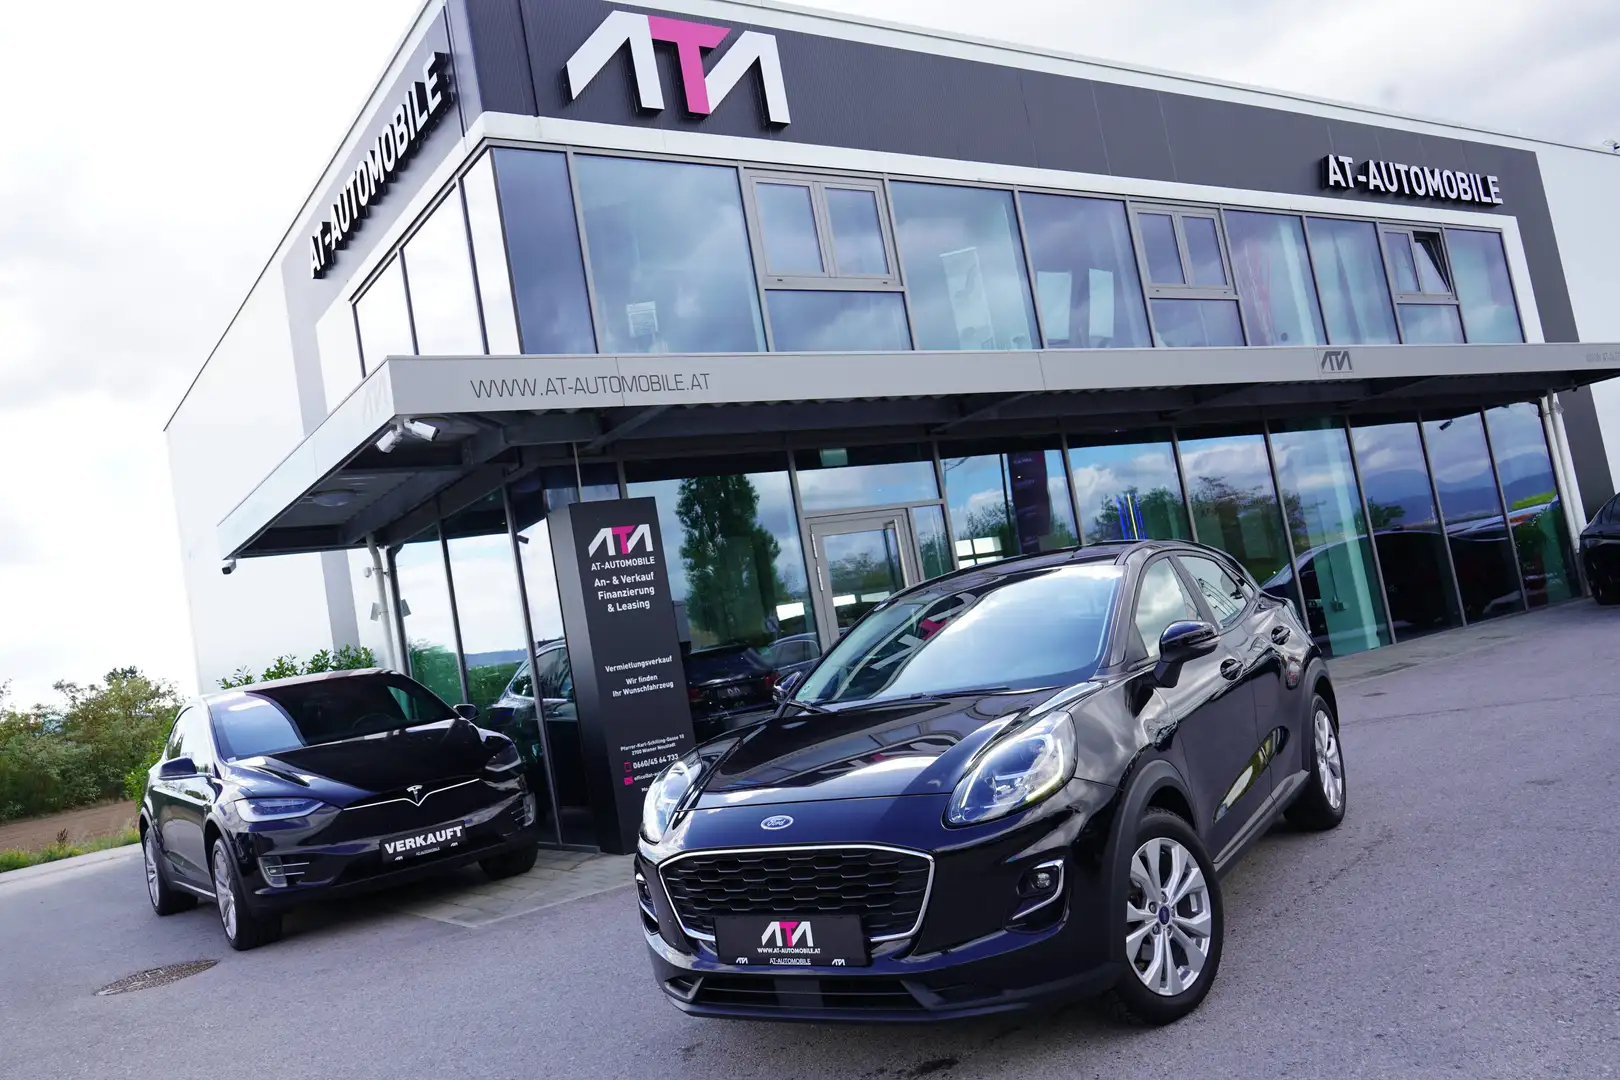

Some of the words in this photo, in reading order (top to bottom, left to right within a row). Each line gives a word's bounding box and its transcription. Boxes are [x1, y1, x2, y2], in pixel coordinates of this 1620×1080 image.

[563, 9, 791, 126] ATA
[309, 51, 446, 279] AT-AUTOMOBILE
[1324, 153, 1504, 205] AT-AUTOMOBILE
[470, 373, 710, 399] WWW.AT-AUTOMOBILE.AT
[588, 523, 653, 558] ATA
[591, 556, 656, 571] AT-AUTOMOBILE
[594, 578, 610, 587] An-
[612, 576, 620, 585] &
[620, 572, 654, 584] Verkauf
[598, 586, 655, 600] Finanzierung
[607, 604, 615, 612] &
[616, 601, 650, 612] Leasing
[605, 655, 673, 673] Vermietungsverkauf
[625, 677, 638, 685] Wir
[638, 674, 658, 684] finden
[612, 689, 622, 698] Ihr
[622, 681, 674, 695] Wunschfahrzeug
[667, 753, 679, 762] 733
[764, 816, 789, 828] Ford
[384, 825, 463, 855] VERKAUFT
[761, 921, 814, 947] ATA
[769, 957, 811, 965] AT-AUTOMOBILE
